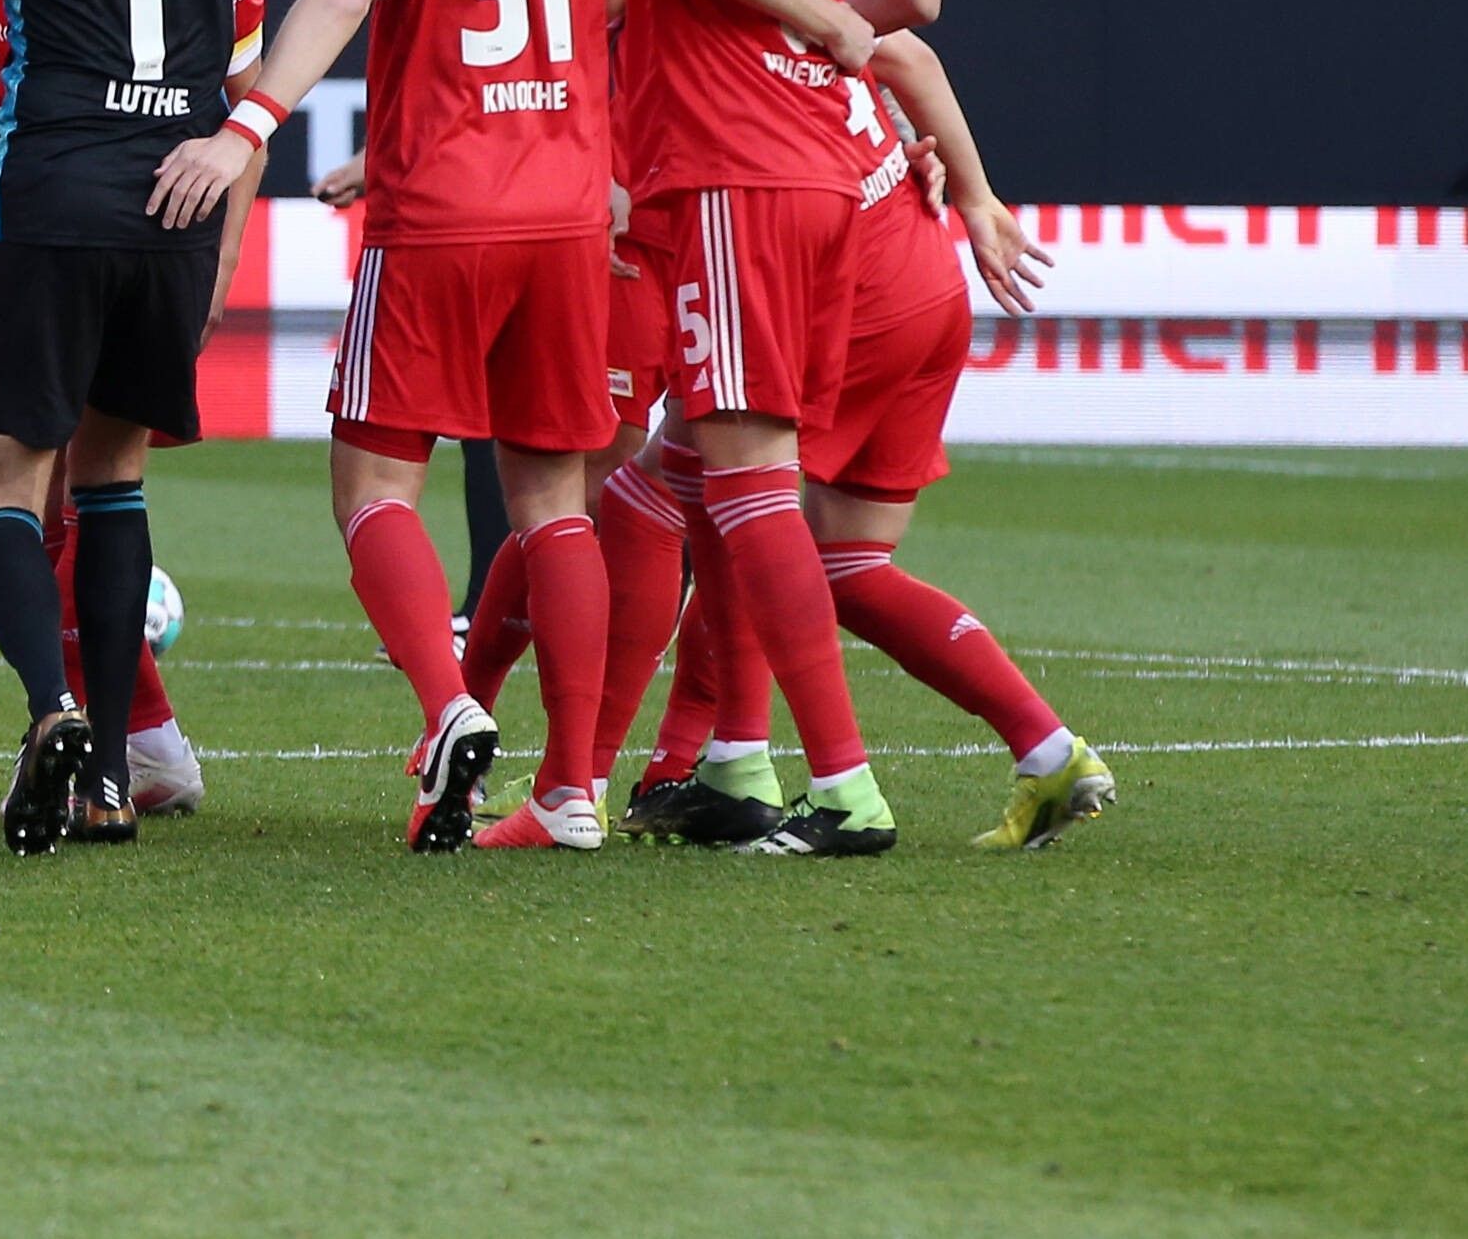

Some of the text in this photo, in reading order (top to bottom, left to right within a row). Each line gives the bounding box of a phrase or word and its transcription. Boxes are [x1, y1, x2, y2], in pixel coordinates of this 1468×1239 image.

[105, 80, 191, 117] LUTHE
[482, 81, 568, 114] KNOCHE
[676, 281, 711, 365] 5
